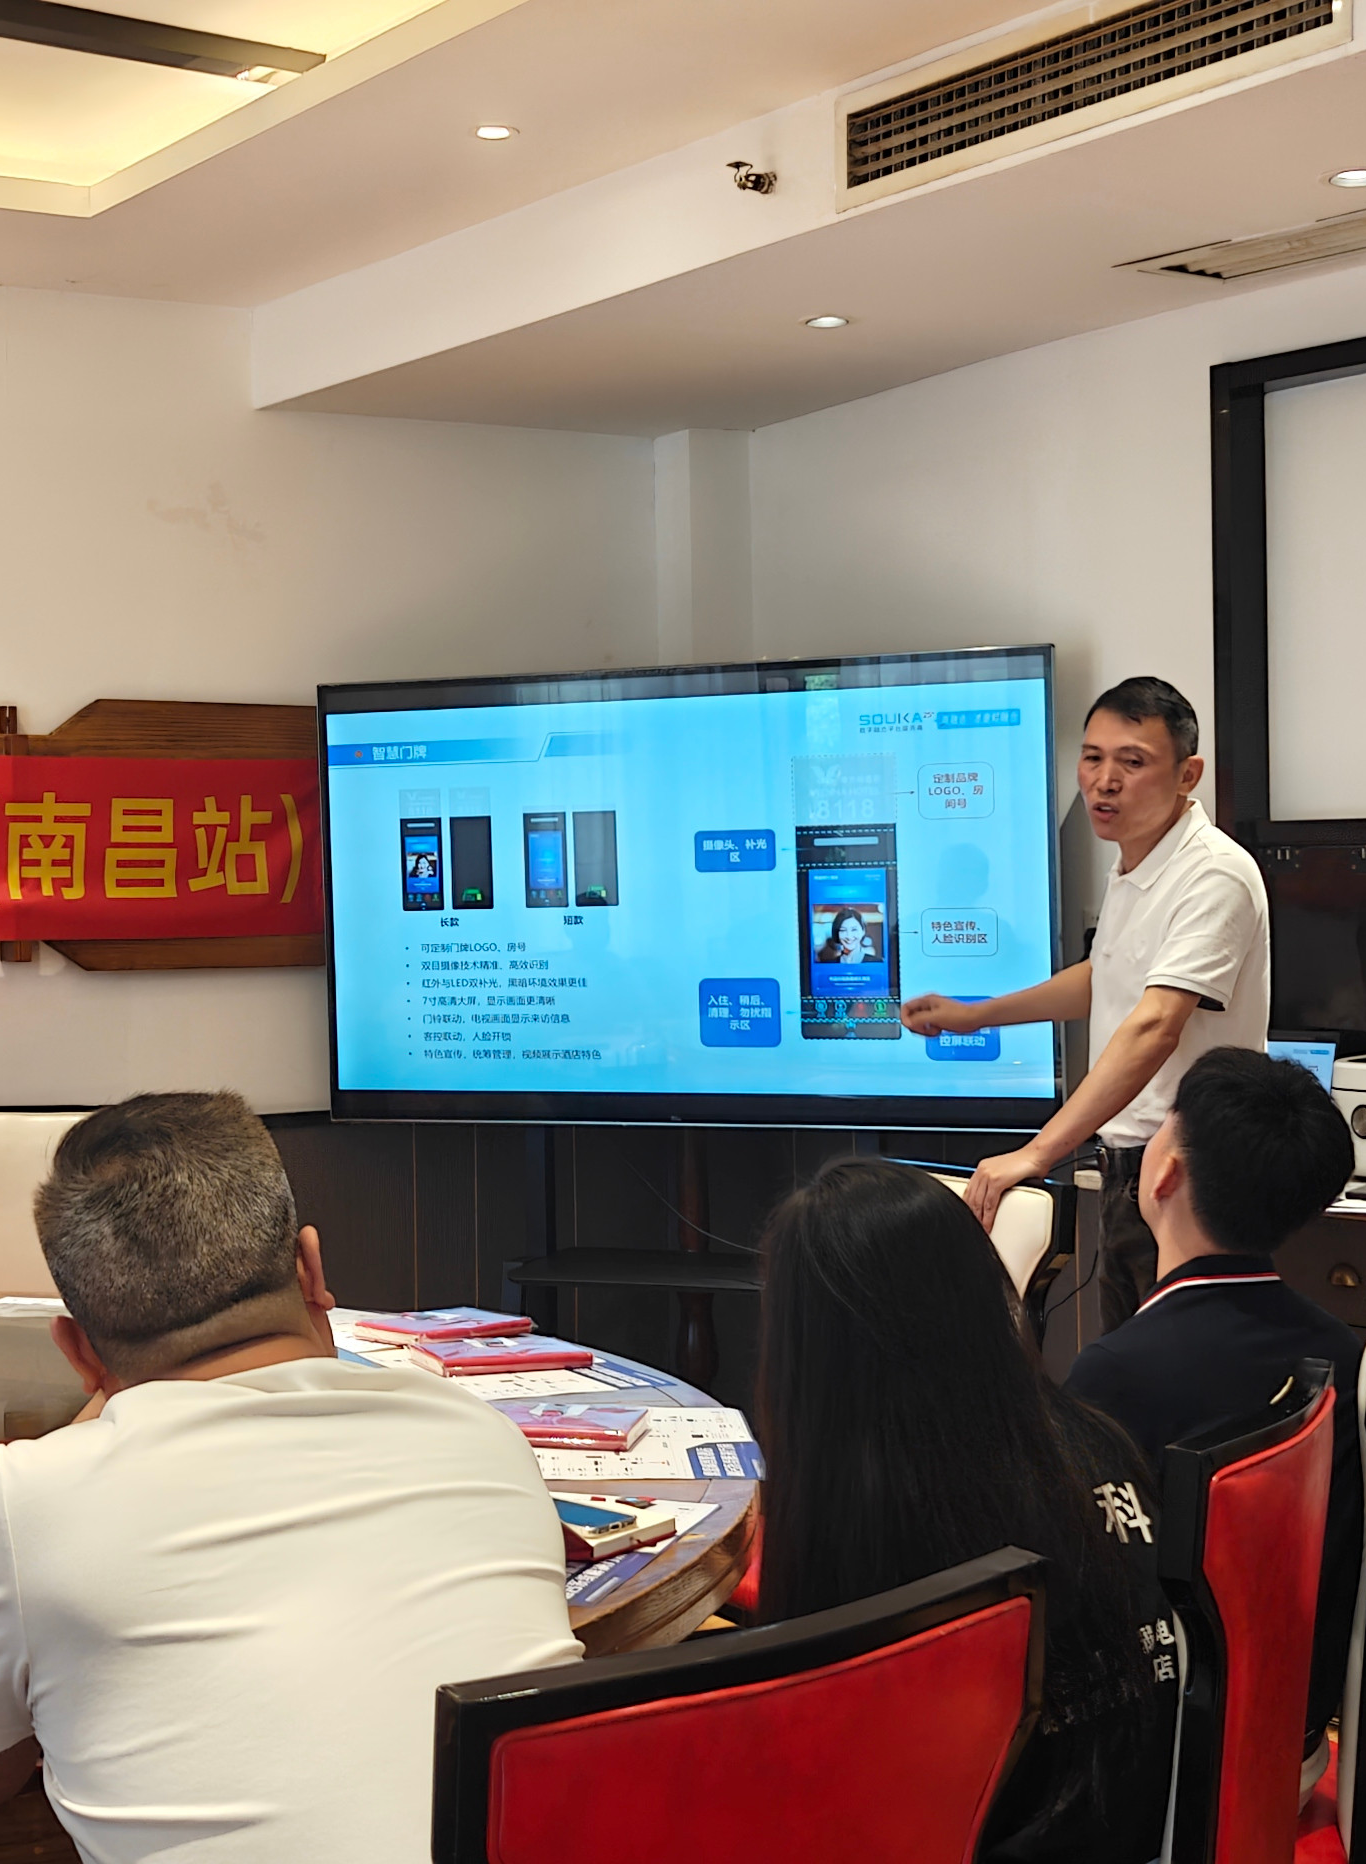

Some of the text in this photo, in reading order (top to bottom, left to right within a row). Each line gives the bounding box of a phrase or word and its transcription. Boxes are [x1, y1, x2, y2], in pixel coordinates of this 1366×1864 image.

[859, 712, 923, 725] SOUKA
[372, 745, 427, 761] 智慧门牌
[933, 773, 979, 784] 定制品牌
[945, 799, 967, 809] 间号
[702, 839, 767, 851] 摄像头、补光
[730, 852, 741, 862] 区
[440, 917, 460, 927] 长款
[563, 915, 584, 926] 短款
[931, 933, 988, 944] 人脸识别区
[729, 1020, 751, 1030] 示区
[1093, 1481, 1153, 1544] 科
